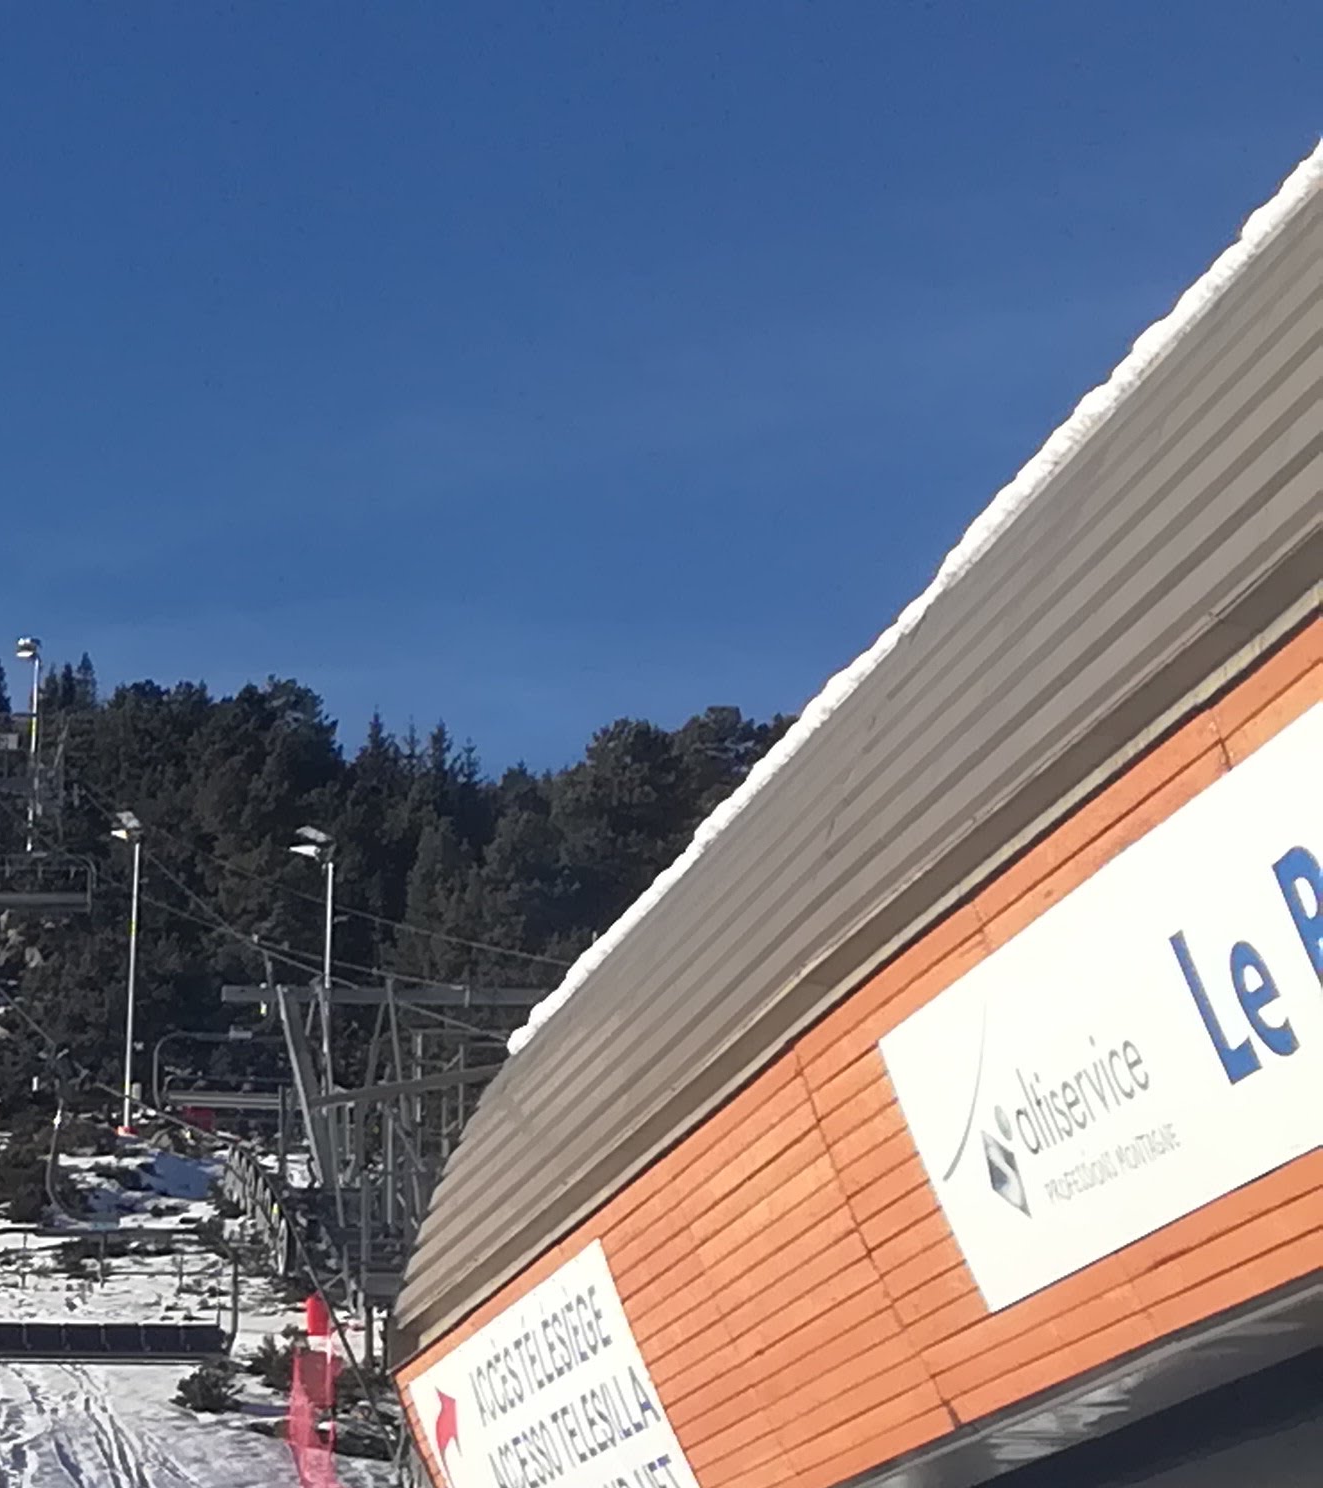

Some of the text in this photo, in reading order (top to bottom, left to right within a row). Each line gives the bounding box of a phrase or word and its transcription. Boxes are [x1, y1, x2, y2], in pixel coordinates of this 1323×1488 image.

[1168, 929, 1300, 1085] Le
[1015, 1035, 1150, 1155] altiservice
[551, 1366, 662, 1469] TELESILLA
